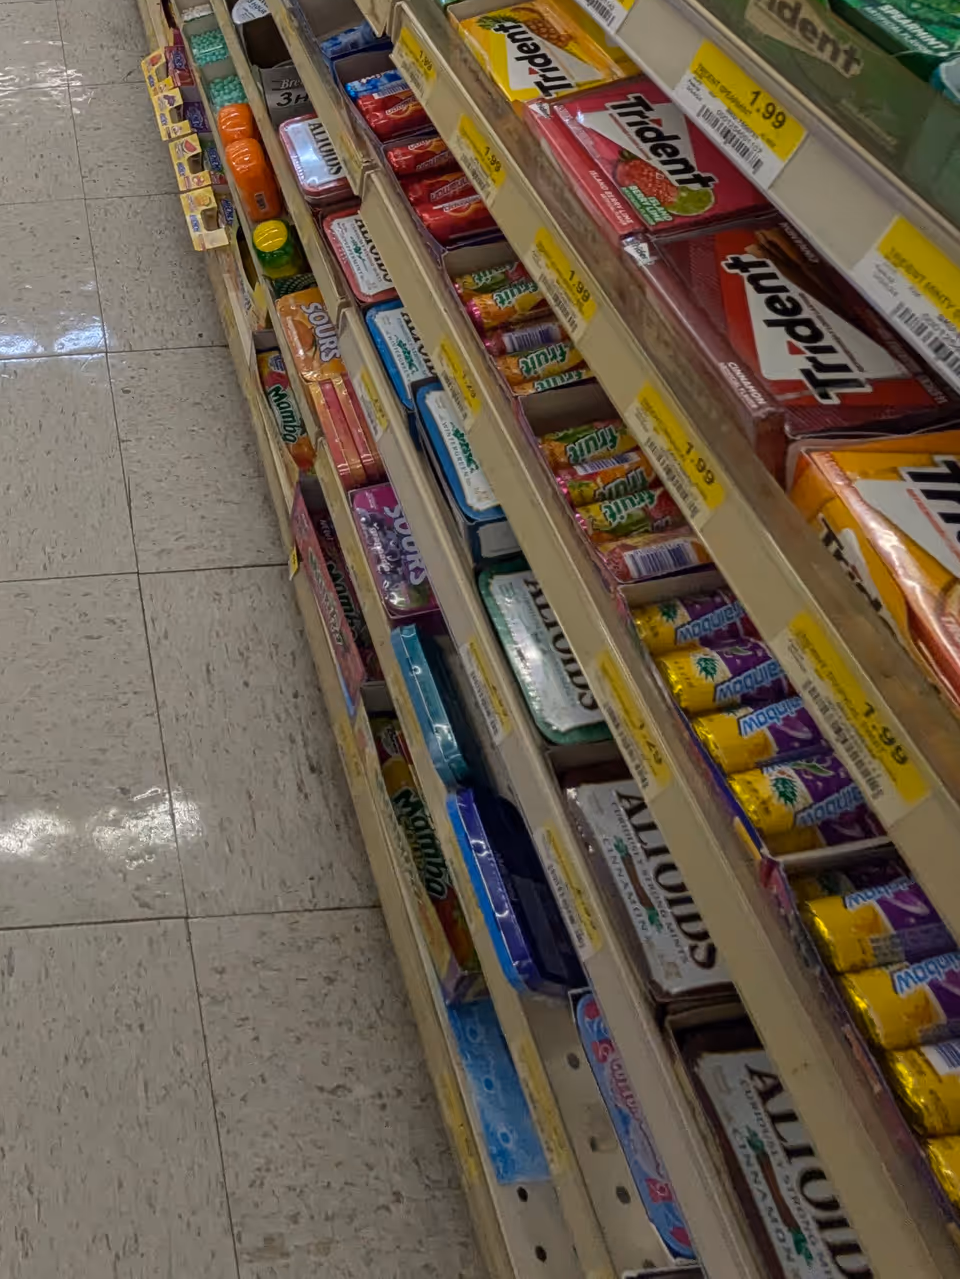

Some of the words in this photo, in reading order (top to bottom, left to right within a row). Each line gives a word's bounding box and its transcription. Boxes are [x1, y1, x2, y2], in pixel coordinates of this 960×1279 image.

[879, 4, 949, 53] SPEARMINT
[494, 19, 576, 99] Trident
[696, 63, 721, 88] TRIDENT
[750, 90, 787, 129] 1.99
[485, 146, 502, 172] 1.99
[606, 95, 717, 190] Trident
[589, 169, 605, 190] ISLAND
[605, 188, 621, 208] BERRY
[620, 205, 635, 224] LIME
[631, 185, 651, 206] BERRY
[648, 203, 664, 223] LIME
[649, 196, 673, 222] ISLAND
[493, 279, 540, 309] fruit
[569, 269, 591, 303] 1.99
[301, 302, 341, 363] SOURS
[722, 254, 873, 404] Trident
[519, 342, 570, 377] fruit
[727, 360, 768, 407] CINNAMON
[266, 384, 305, 445] Mambo
[566, 426, 619, 465] fruit
[685, 440, 716, 486] 1.99
[603, 490, 656, 524] fruit
[384, 504, 427, 585] SOURS
[715, 660, 788, 705] ainbow
[740, 697, 806, 737] ainbow
[863, 701, 909, 766] 1.99
[797, 784, 866, 827] ainbow
[392, 787, 453, 900] Mambo
[602, 836, 651, 937] CINNAMON
[665, 921, 689, 965] MINTS
[731, 1126, 796, 1265] CINNAMON
[781, 1173, 819, 1248] STRONG
